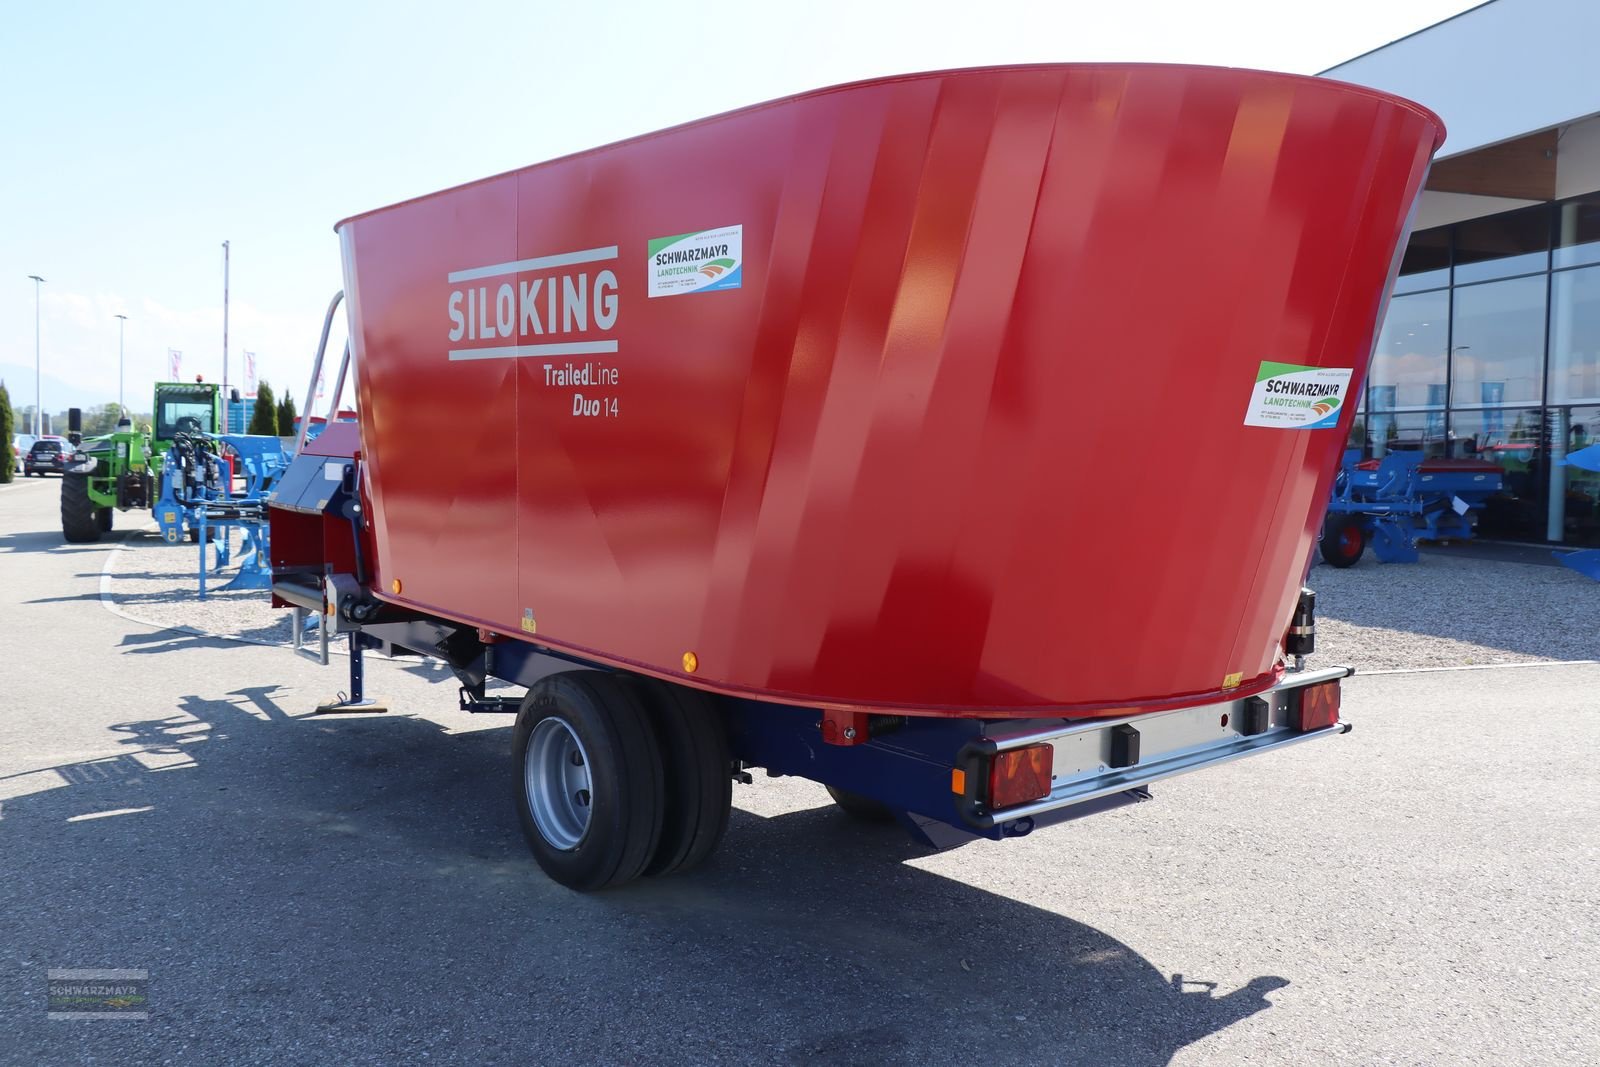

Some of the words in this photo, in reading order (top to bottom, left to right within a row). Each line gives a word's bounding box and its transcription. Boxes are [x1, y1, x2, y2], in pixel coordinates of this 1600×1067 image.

[656, 244, 728, 266] SCHWARZMAYR
[657, 265, 698, 278] LANDTECHNIK
[448, 269, 618, 342] SILOKING
[544, 362, 618, 386] TrailedLine
[1265, 379, 1340, 397] SCHWARZMAYR
[573, 394, 600, 416] Duo
[604, 397, 618, 417] 14
[1264, 396, 1312, 409] LANDTECHNIK
